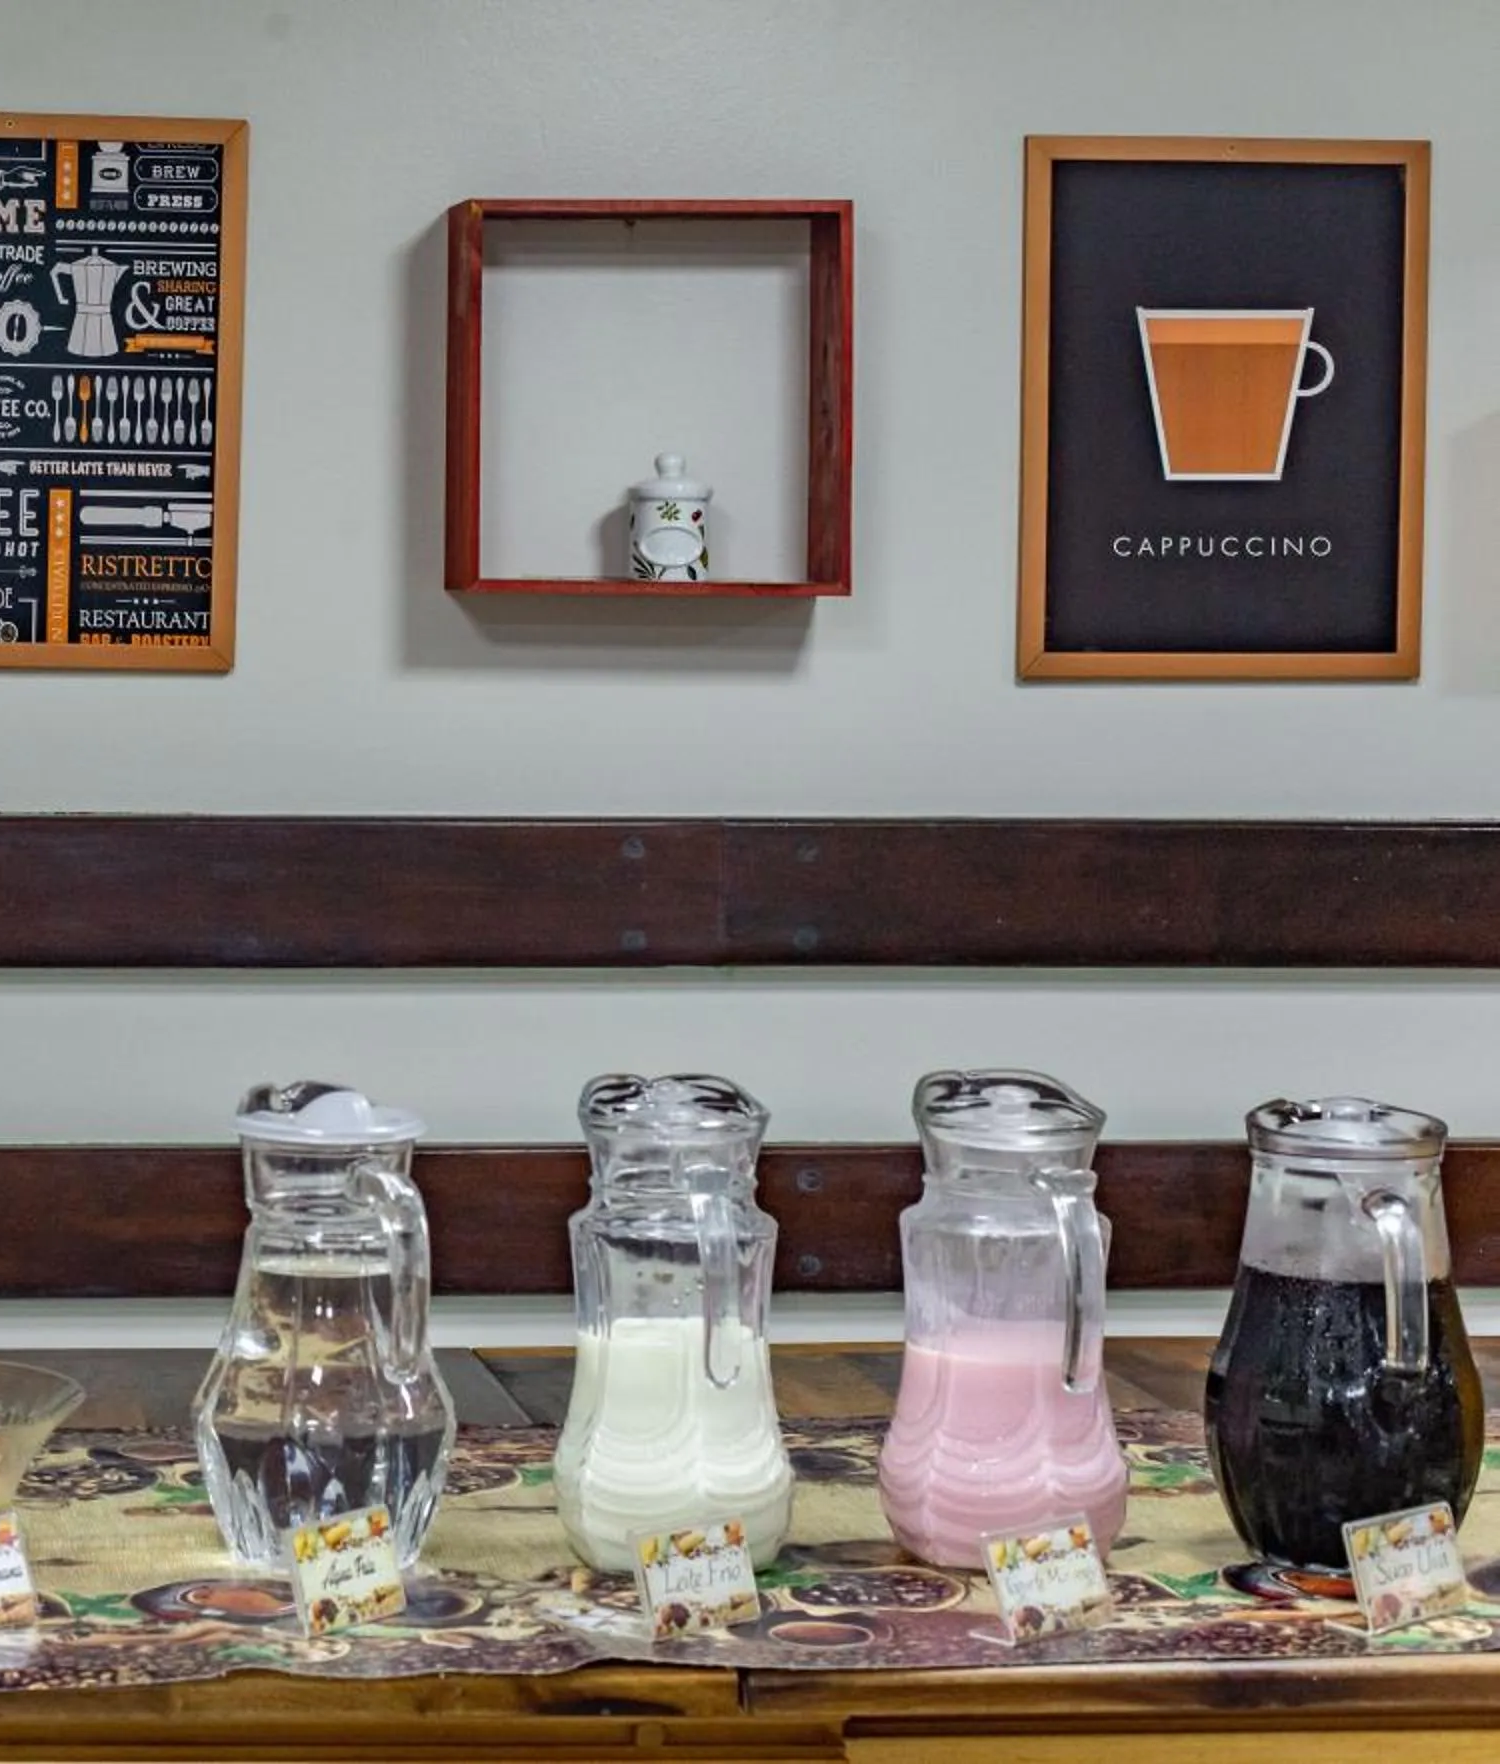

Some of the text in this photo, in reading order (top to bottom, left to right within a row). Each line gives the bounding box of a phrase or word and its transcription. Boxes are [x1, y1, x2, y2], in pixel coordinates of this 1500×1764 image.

[152, 165, 201, 179] BREW
[147, 193, 204, 208] PRESS
[133, 260, 217, 277] BREWING
[125, 281, 165, 330] &
[165, 296, 215, 312] GREAT
[25, 400, 51, 418] CO.
[29, 460, 172, 477] BETTER LATTE THAN NEVER
[4, 542, 41, 557] HOT
[1113, 536, 1332, 557] CAPPUCCINO
[80, 555, 212, 579] RISTRETTO
[79, 609, 211, 630] RESTAURANT
